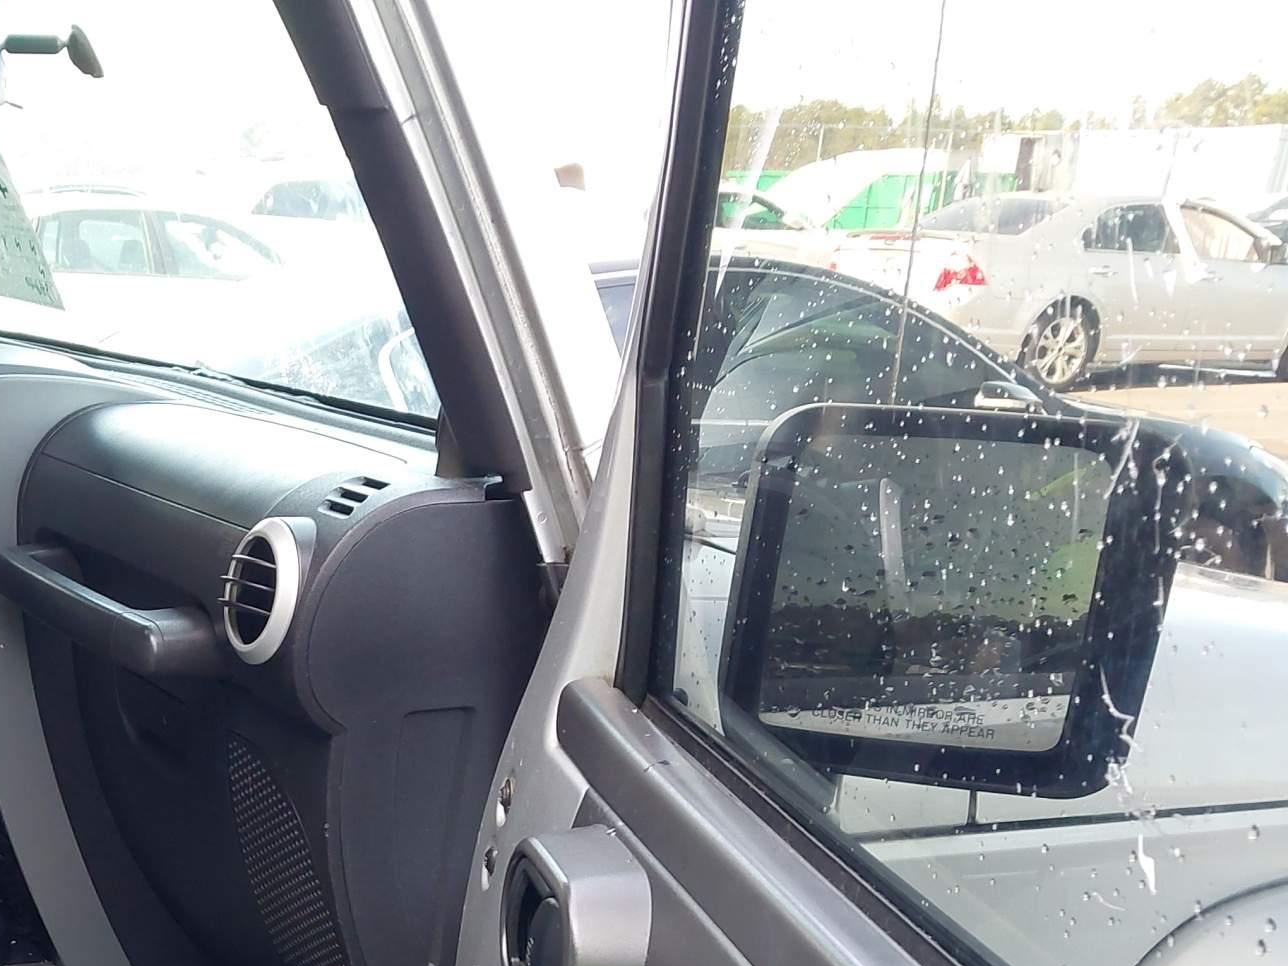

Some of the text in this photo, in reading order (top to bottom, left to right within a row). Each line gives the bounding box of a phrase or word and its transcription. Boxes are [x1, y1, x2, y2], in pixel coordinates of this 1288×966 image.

[811, 709, 996, 740] CLOSER THAN THEY APPEAR
[956, 712, 985, 725] ARE
